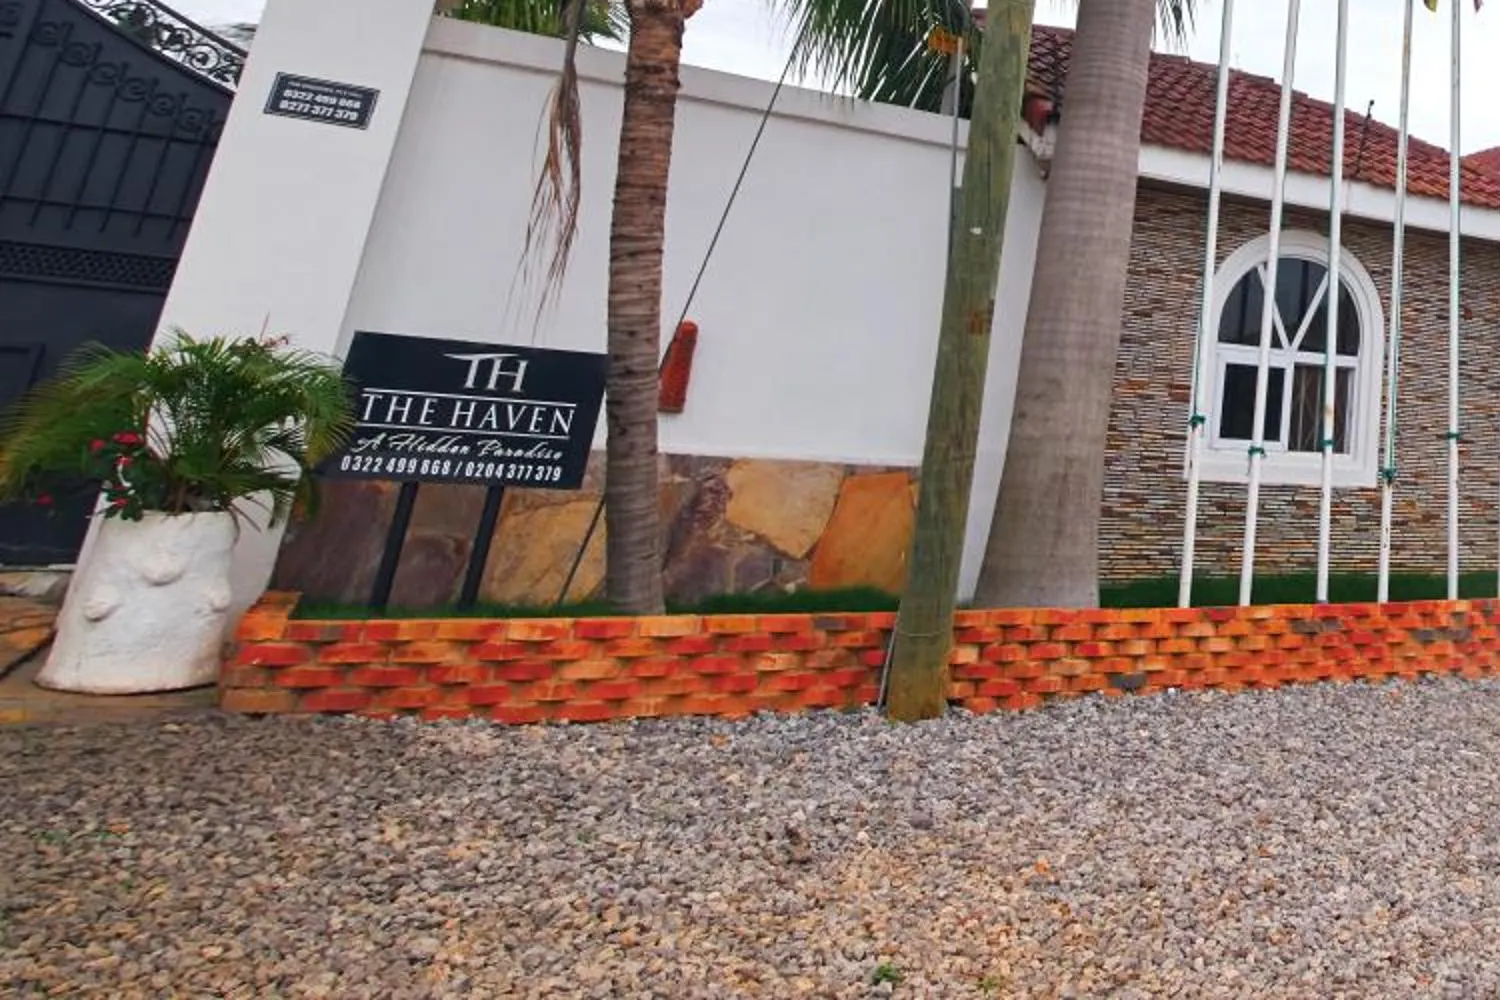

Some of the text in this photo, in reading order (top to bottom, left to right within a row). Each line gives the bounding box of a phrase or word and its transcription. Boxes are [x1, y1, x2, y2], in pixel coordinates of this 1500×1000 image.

[444, 352, 529, 393] TH
[360, 393, 576, 435] THE HAVEN
[350, 432, 563, 460] A Hidden Paradise
[340, 455, 383, 472] 0322
